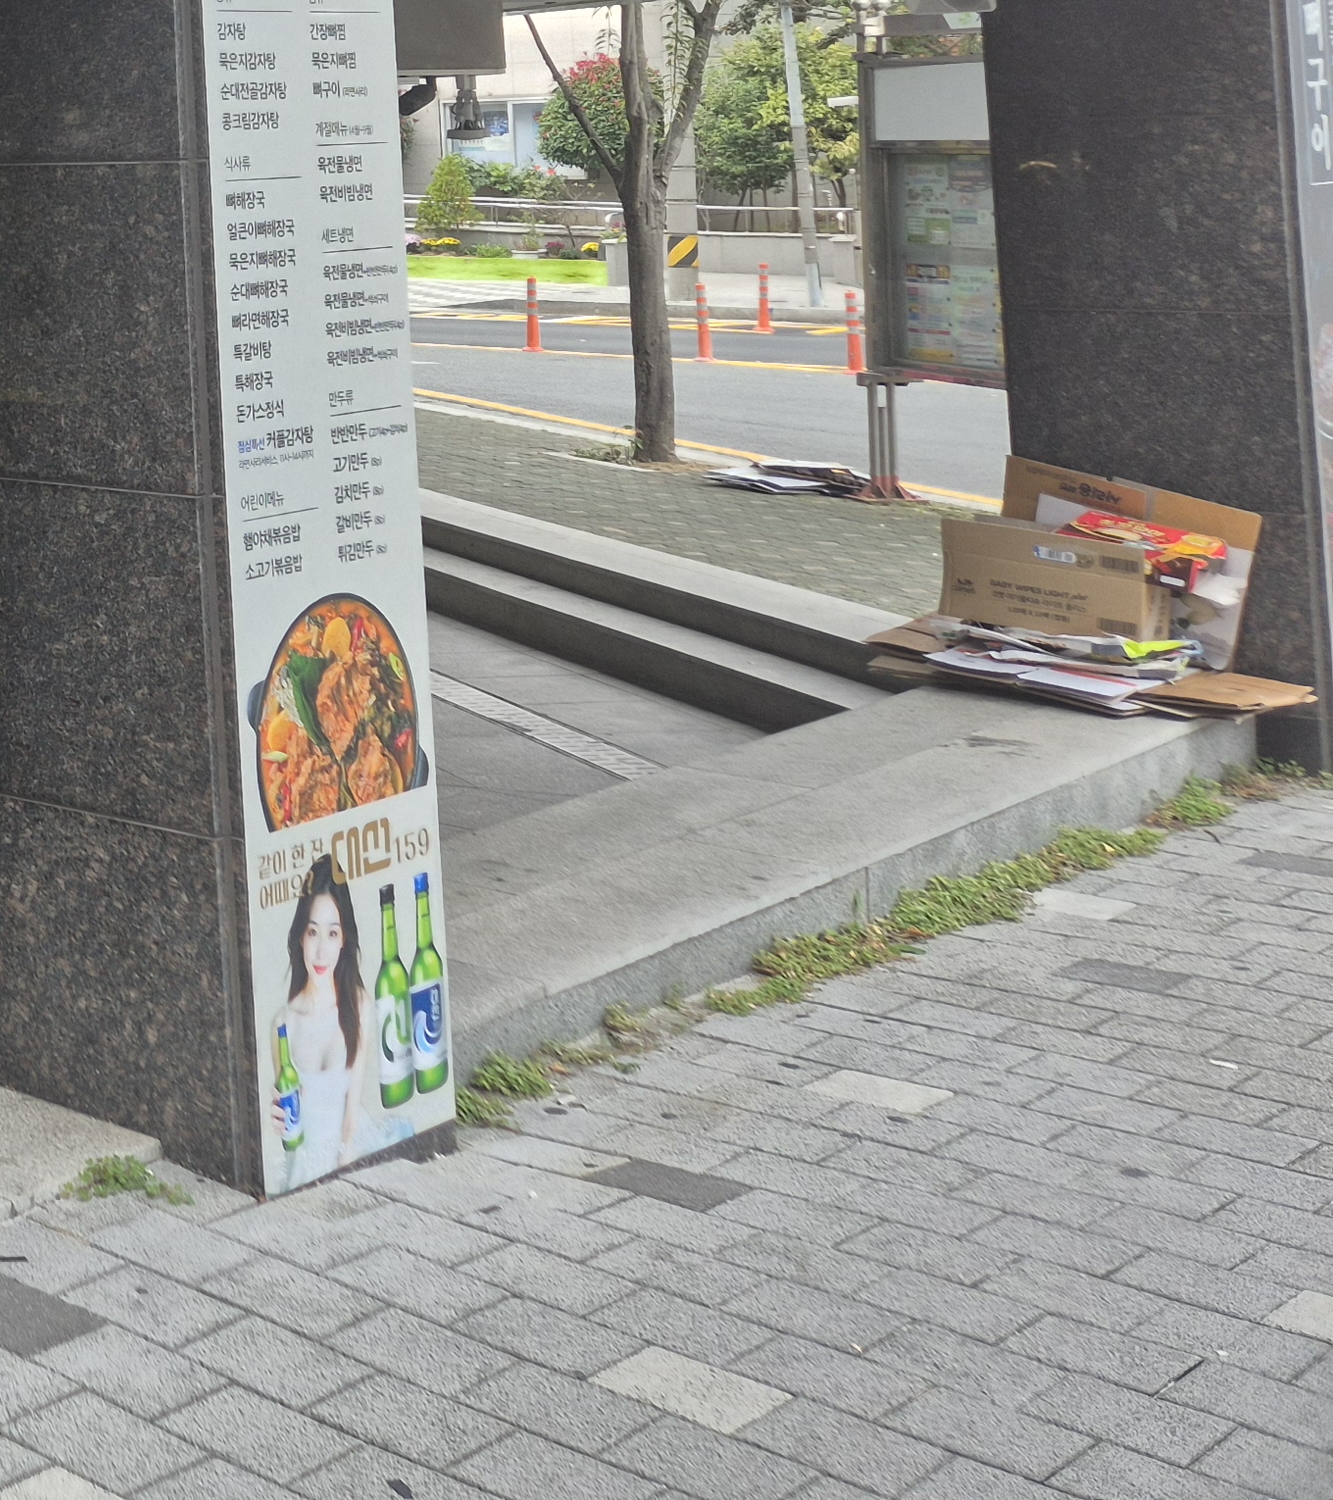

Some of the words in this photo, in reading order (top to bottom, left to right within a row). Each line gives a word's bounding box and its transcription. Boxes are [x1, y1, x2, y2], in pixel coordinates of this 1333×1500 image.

[217, 22, 246, 41] 감자탕
[309, 22, 346, 41] 간장뼈찜
[219, 52, 276, 71] 묵은지감자탕
[311, 51, 357, 70] 묵은지뼈찜
[220, 81, 287, 101] 순대전골감자탕
[312, 80, 341, 99] 뼈구이
[221, 111, 279, 131] 콩크림감자탕
[315, 121, 348, 138] 계절메뉴
[224, 155, 251, 173] 식사류
[317, 155, 363, 174] 육전물냉면
[225, 191, 266, 210] 뼈해장국
[319, 183, 373, 202] 육전비빔냉면
[227, 219, 295, 241] 얼큰이뼈해장국
[321, 226, 355, 244] 세트냉면
[229, 249, 297, 271] 묵은지뼈해장국
[230, 279, 289, 302] 순대뼈해장국
[231, 308, 290, 331] 뼈라면해장국
[233, 340, 272, 362] 특갈비탕
[235, 371, 274, 392] 특해장국
[328, 389, 354, 408] 만두류
[236, 399, 284, 423] 돈가스정식
[266, 425, 314, 449] 커플감자탕
[330, 422, 368, 445] 반반만두
[333, 452, 369, 473] 고기만두
[240, 491, 285, 512] 어린이메뉴
[334, 481, 371, 504] 김치만두
[335, 510, 373, 534] 갈비만두
[243, 523, 302, 551] 햄야채볶음밥
[337, 540, 375, 563] 튀김만두
[245, 553, 303, 580] 소고기볶음밥
[393, 827, 430, 864] 159
[258, 850, 287, 880] 같이
[290, 844, 305, 869] 한
